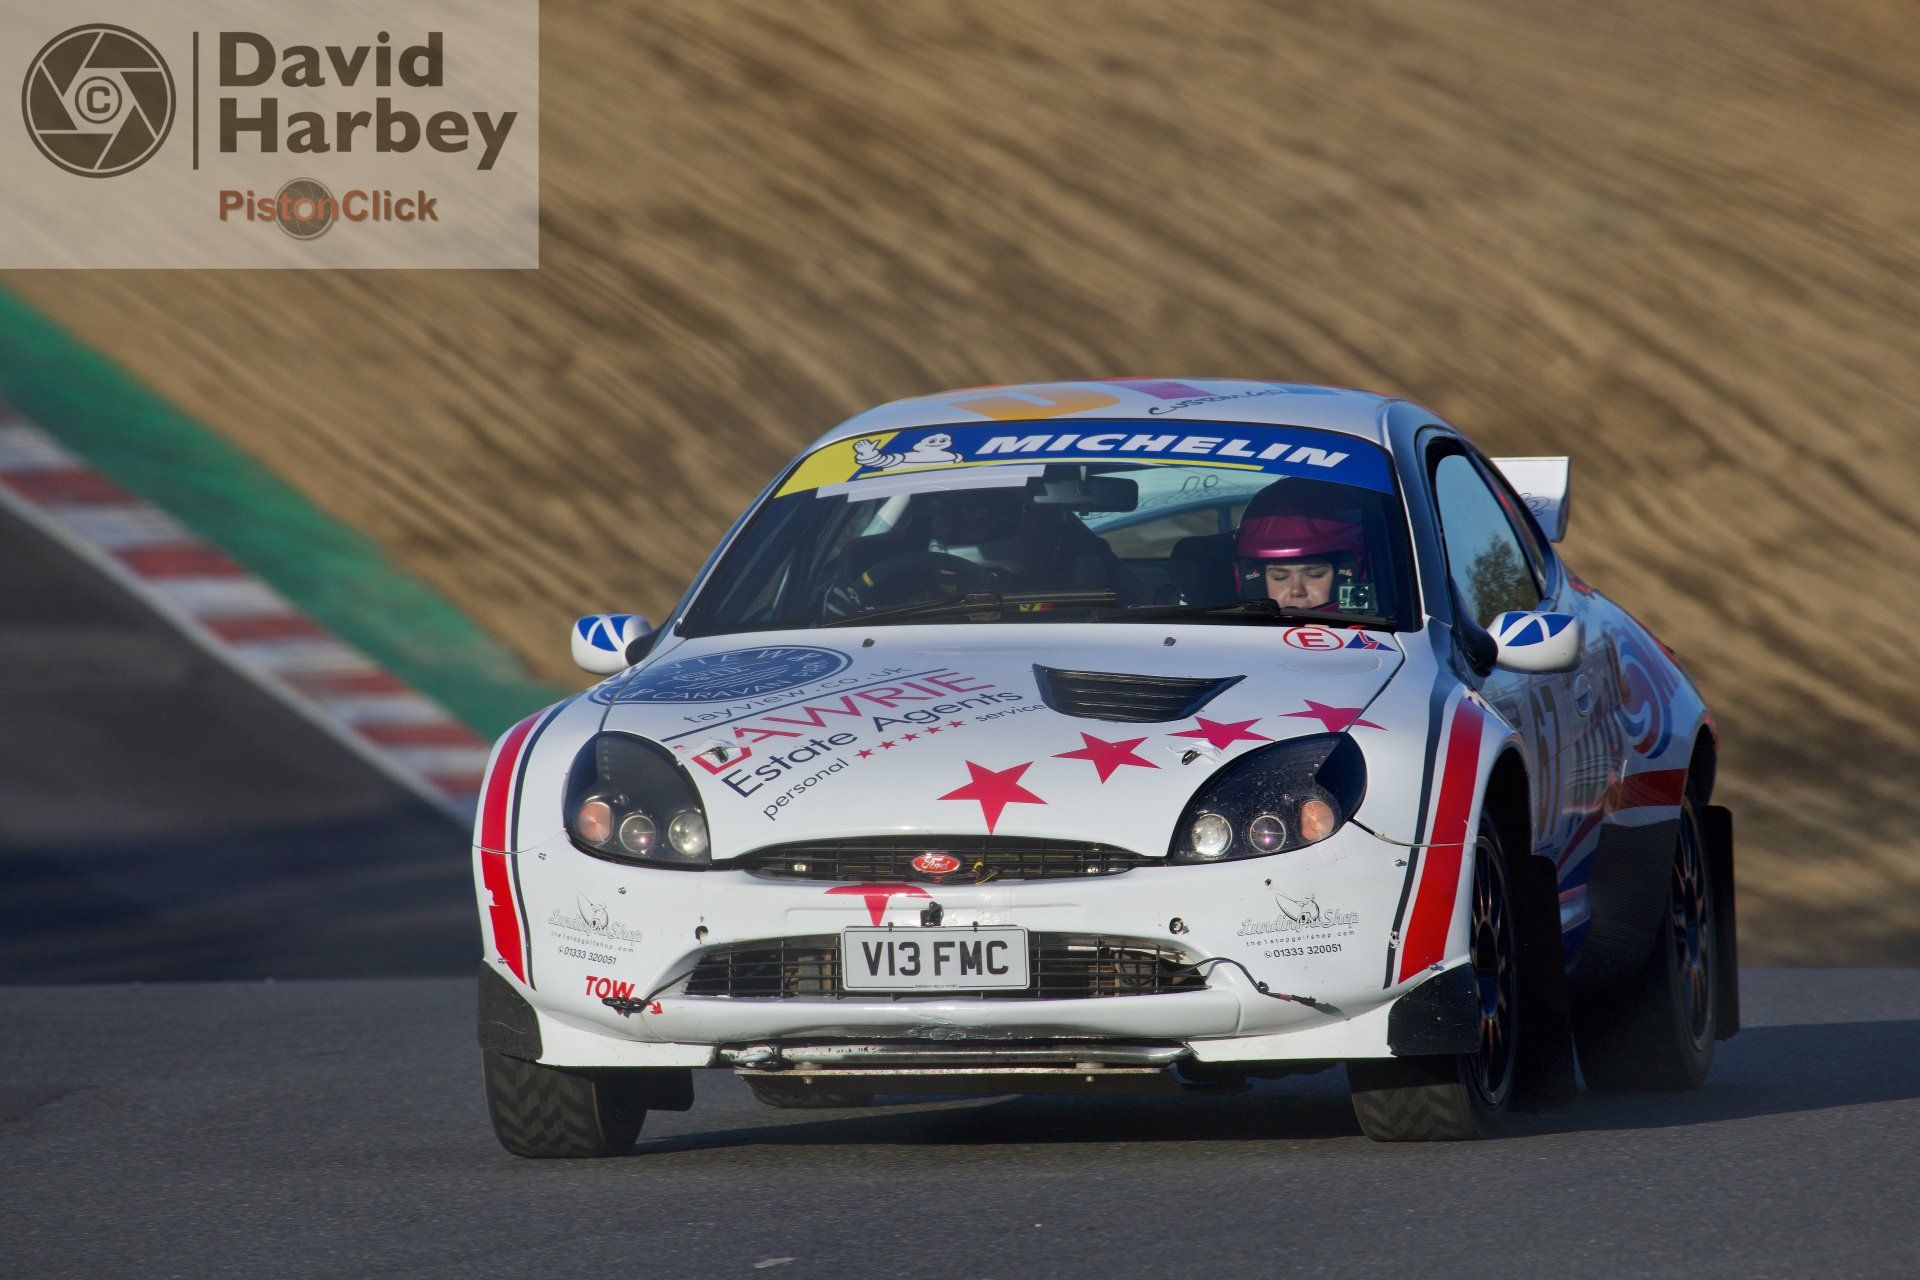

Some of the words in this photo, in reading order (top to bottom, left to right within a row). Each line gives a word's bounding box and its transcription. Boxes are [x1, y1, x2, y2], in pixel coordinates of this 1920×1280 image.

[975, 433, 1350, 468] MICHELIN
[1296, 632, 1331, 648] E
[721, 731, 858, 798] Estate
[872, 690, 1024, 732] Agents
[763, 757, 850, 821] personal
[976, 704, 1046, 721] service
[563, 946, 587, 960] 01333
[588, 952, 617, 966] 320051
[862, 941, 921, 977] V13
[933, 941, 1009, 976] FMC
[1273, 947, 1304, 958] 01333
[1307, 943, 1342, 956] 320051
[585, 975, 636, 1000] TOW
